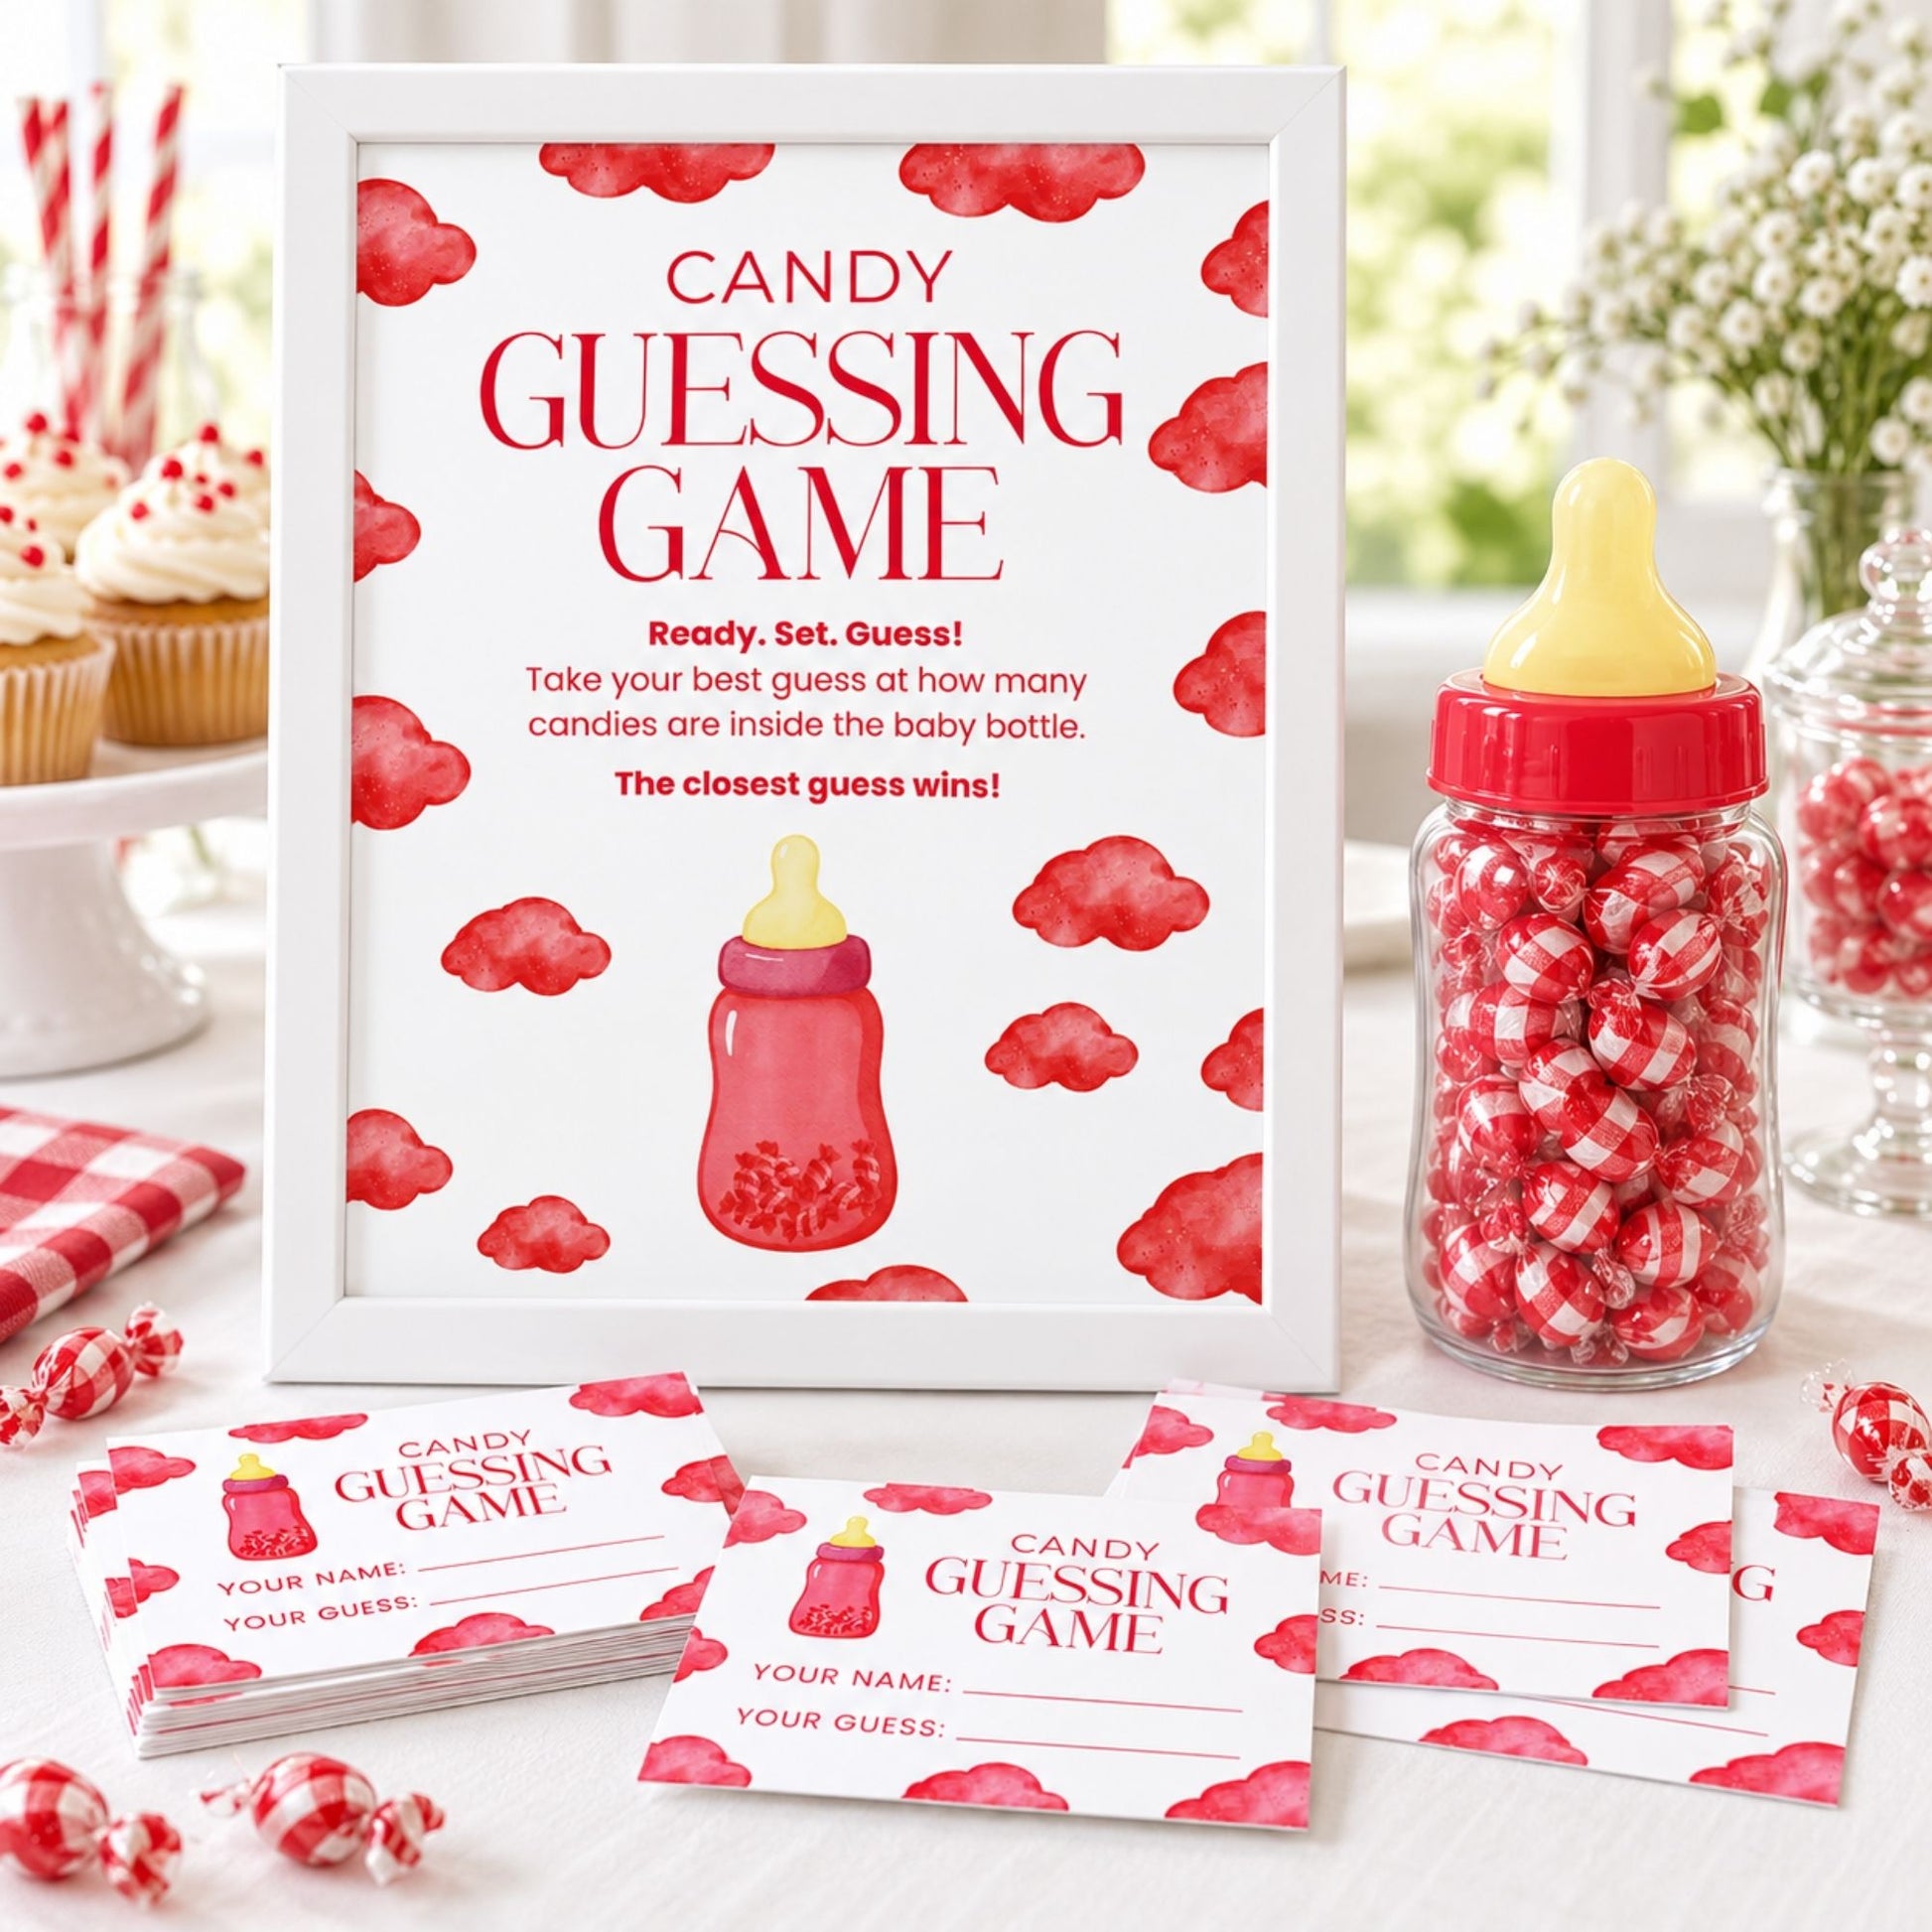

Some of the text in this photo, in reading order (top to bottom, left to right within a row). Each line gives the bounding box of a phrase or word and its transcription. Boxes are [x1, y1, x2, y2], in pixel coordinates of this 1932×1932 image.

[666, 249, 952, 305] CANDY
[480, 330, 1123, 451] GUESSING
[598, 465, 1004, 583] GAME
[648, 620, 962, 654] Ready. Set. Guess!
[526, 666, 1087, 701] Take your best guess at how many
[528, 711, 1085, 747] candies are inside the baby bottle.
[615, 769, 1000, 805] The closest guess wins!
[398, 1429, 531, 1459] CANDY
[335, 1444, 612, 1504] GUESSING
[1416, 1452, 1563, 1481] CANDY
[395, 1483, 567, 1531] GAME
[1332, 1470, 1637, 1528] GUESSING
[1011, 1533, 1161, 1561] CANDY
[1381, 1513, 1569, 1562] GAME
[218, 1562, 405, 1595] YOUR NAME:
[925, 1556, 1228, 1614] GUESSING
[1319, 1570, 1368, 1587] ME:
[225, 1596, 418, 1631] YOUR GUESS:
[974, 1603, 1163, 1655] GAME
[1319, 1607, 1364, 1626] SS:
[756, 1664, 951, 1693] YOUR NAME:
[738, 1708, 944, 1738] YOUR GUESS:
